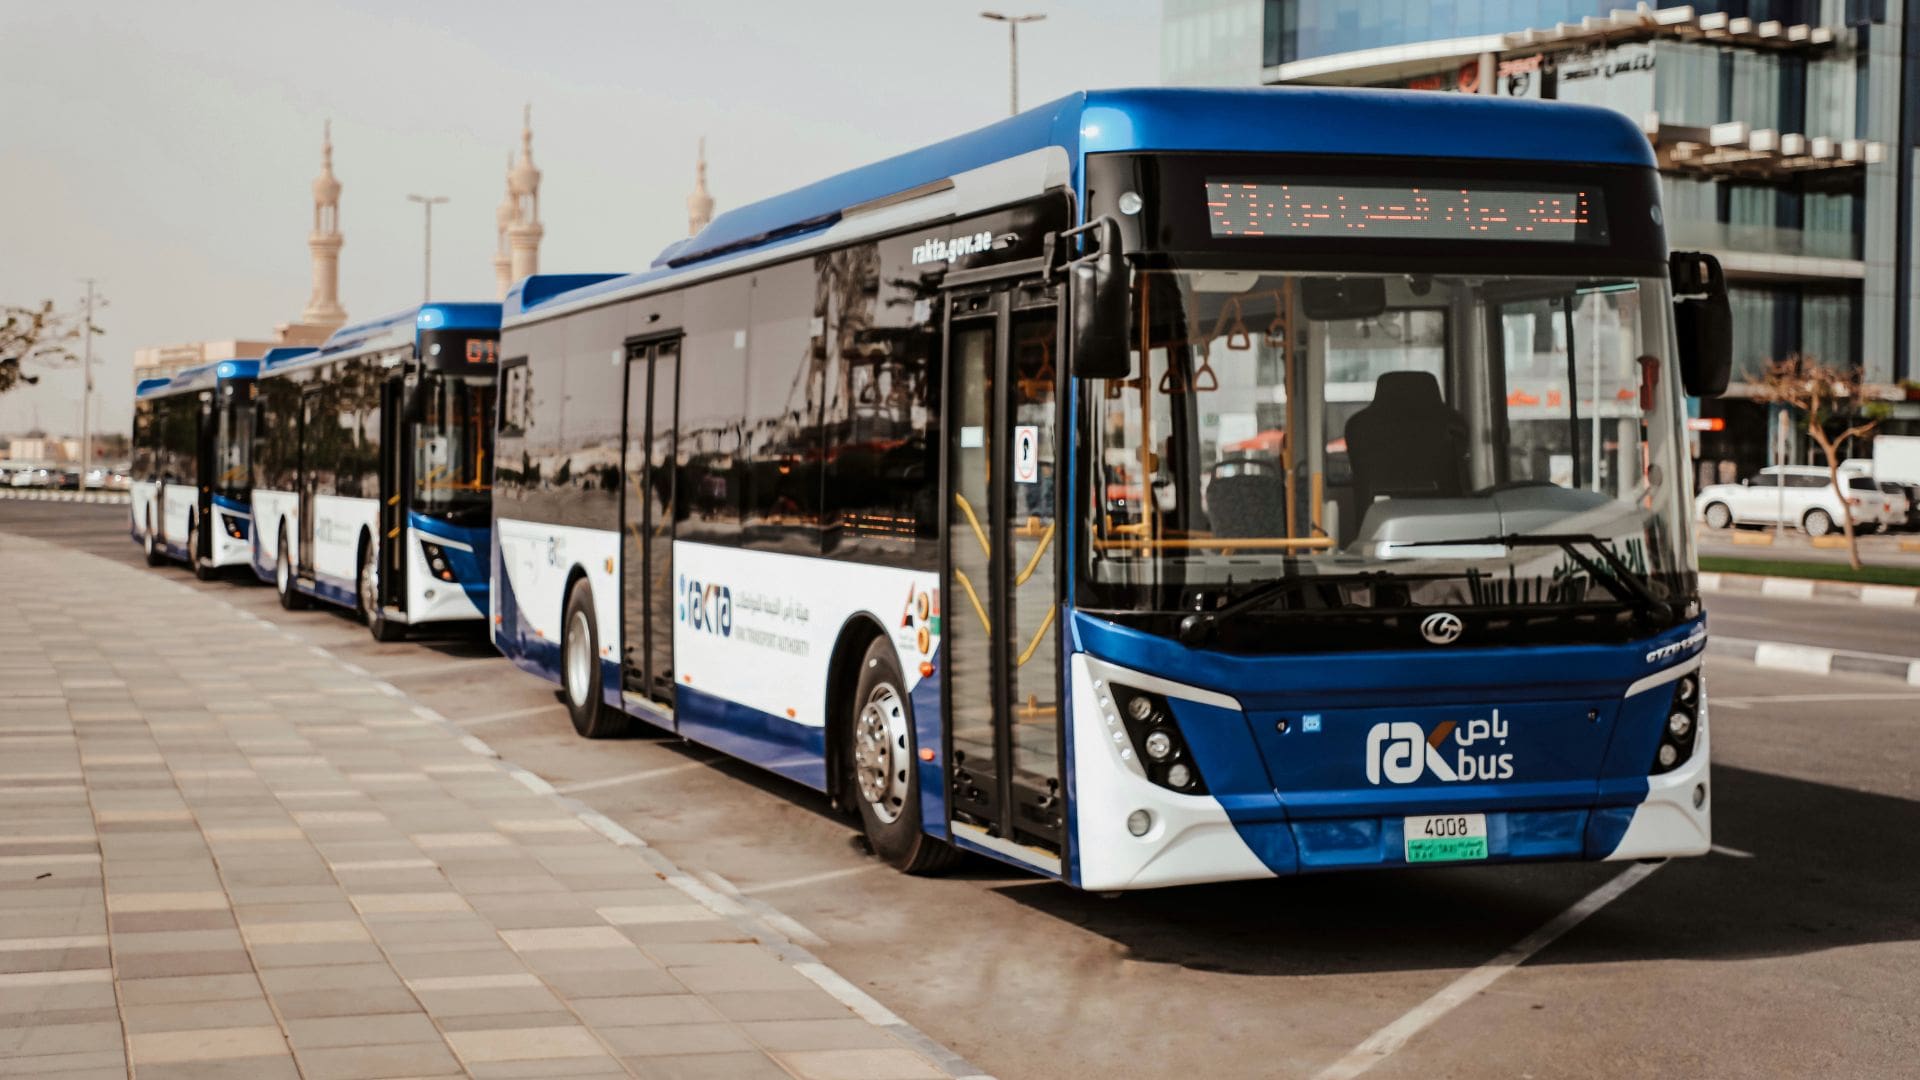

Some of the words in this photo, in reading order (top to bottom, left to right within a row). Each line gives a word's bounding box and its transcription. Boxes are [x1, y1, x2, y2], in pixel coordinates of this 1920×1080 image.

[911, 231, 992, 265] rakta.gov.ae
[1455, 708, 1509, 747] باص
[1457, 748, 1515, 781] bus
[1424, 817, 1468, 837] 4008
